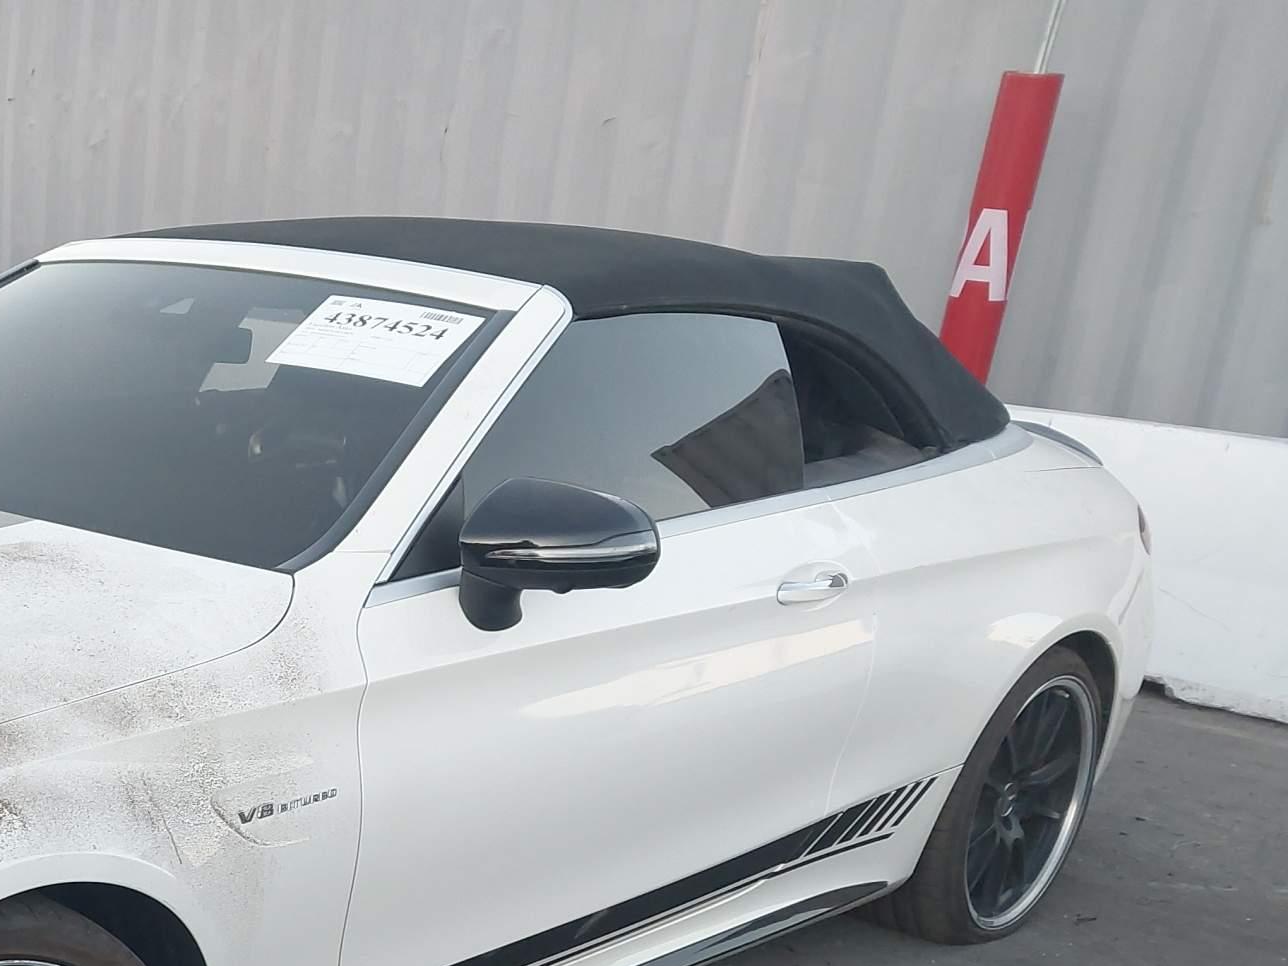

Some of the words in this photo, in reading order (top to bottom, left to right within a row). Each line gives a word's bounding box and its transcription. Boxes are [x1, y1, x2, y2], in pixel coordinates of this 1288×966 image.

[951, 208, 1009, 301] A
[324, 311, 449, 340] 43874524
[238, 802, 274, 824] V8
[279, 788, 337, 813] BITURBO
